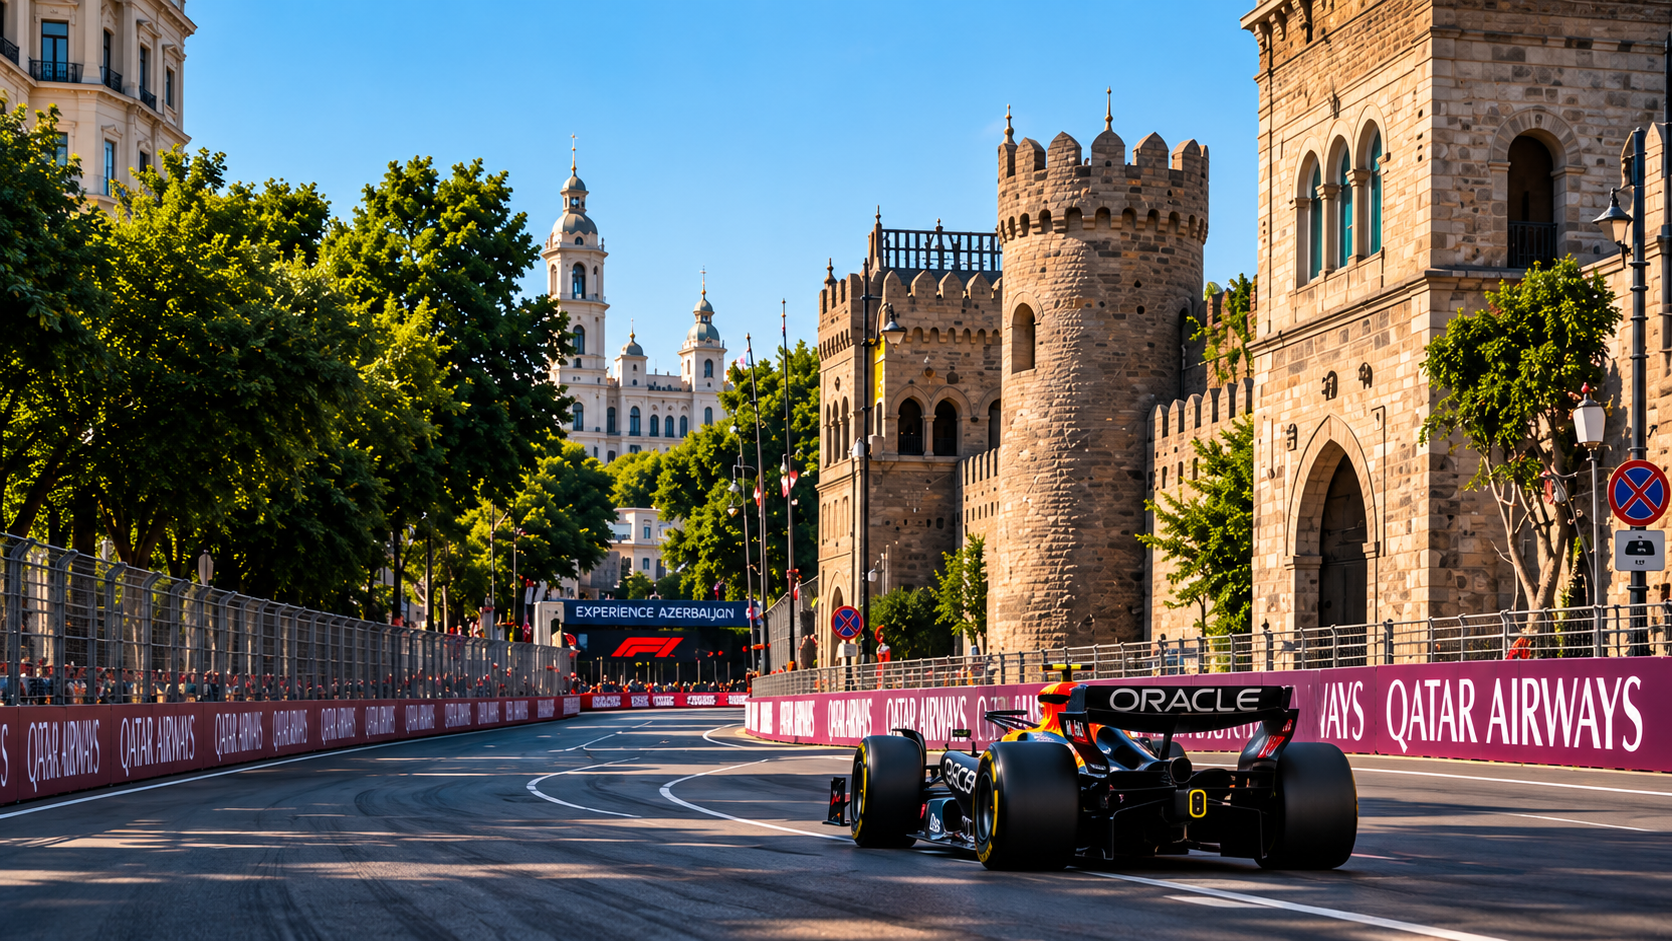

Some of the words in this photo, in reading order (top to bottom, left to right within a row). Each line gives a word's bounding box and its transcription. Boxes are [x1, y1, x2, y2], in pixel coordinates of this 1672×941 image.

[611, 637, 684, 657] F1
[886, 697, 917, 737] QATAR
[918, 695, 968, 742] AIRWAYS
[1109, 688, 1262, 712] ORACLE
[1386, 678, 1478, 754] QATAR
[1486, 675, 1643, 752] AIRWAYS
[120, 717, 154, 777] QATAR
[156, 714, 195, 764] AIRWAYS
